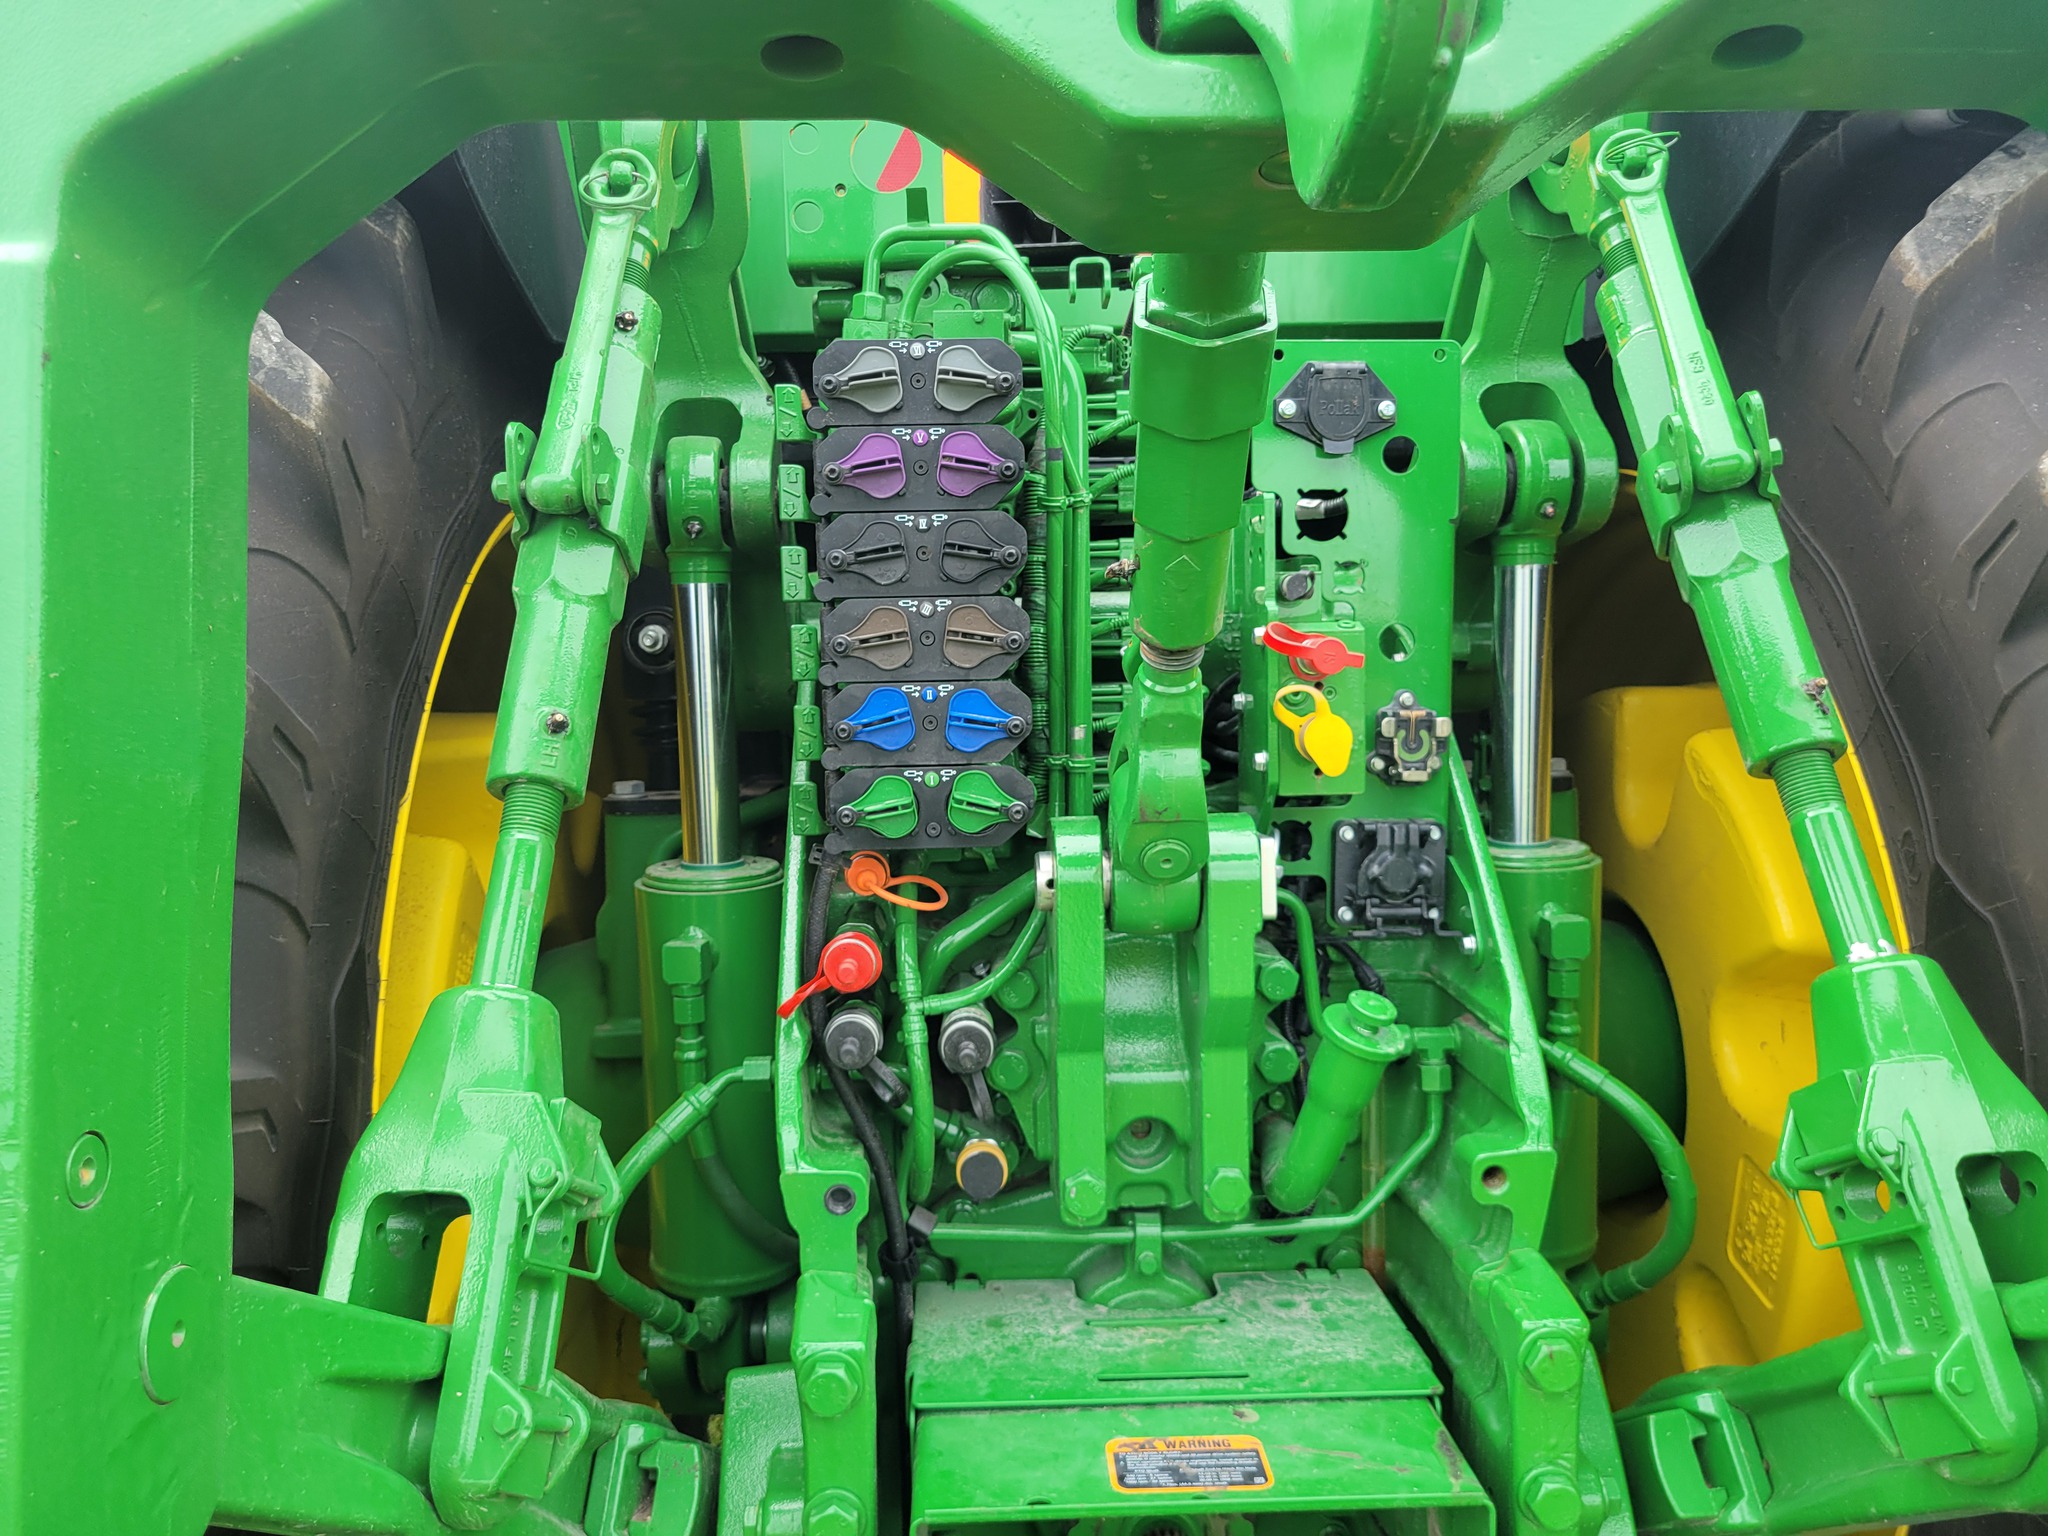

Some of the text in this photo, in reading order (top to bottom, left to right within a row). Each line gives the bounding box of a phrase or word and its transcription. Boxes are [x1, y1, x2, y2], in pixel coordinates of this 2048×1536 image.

[912, 346, 922, 356] VI
[921, 604, 932, 615] III
[1163, 1438, 1232, 1449] WARNING
